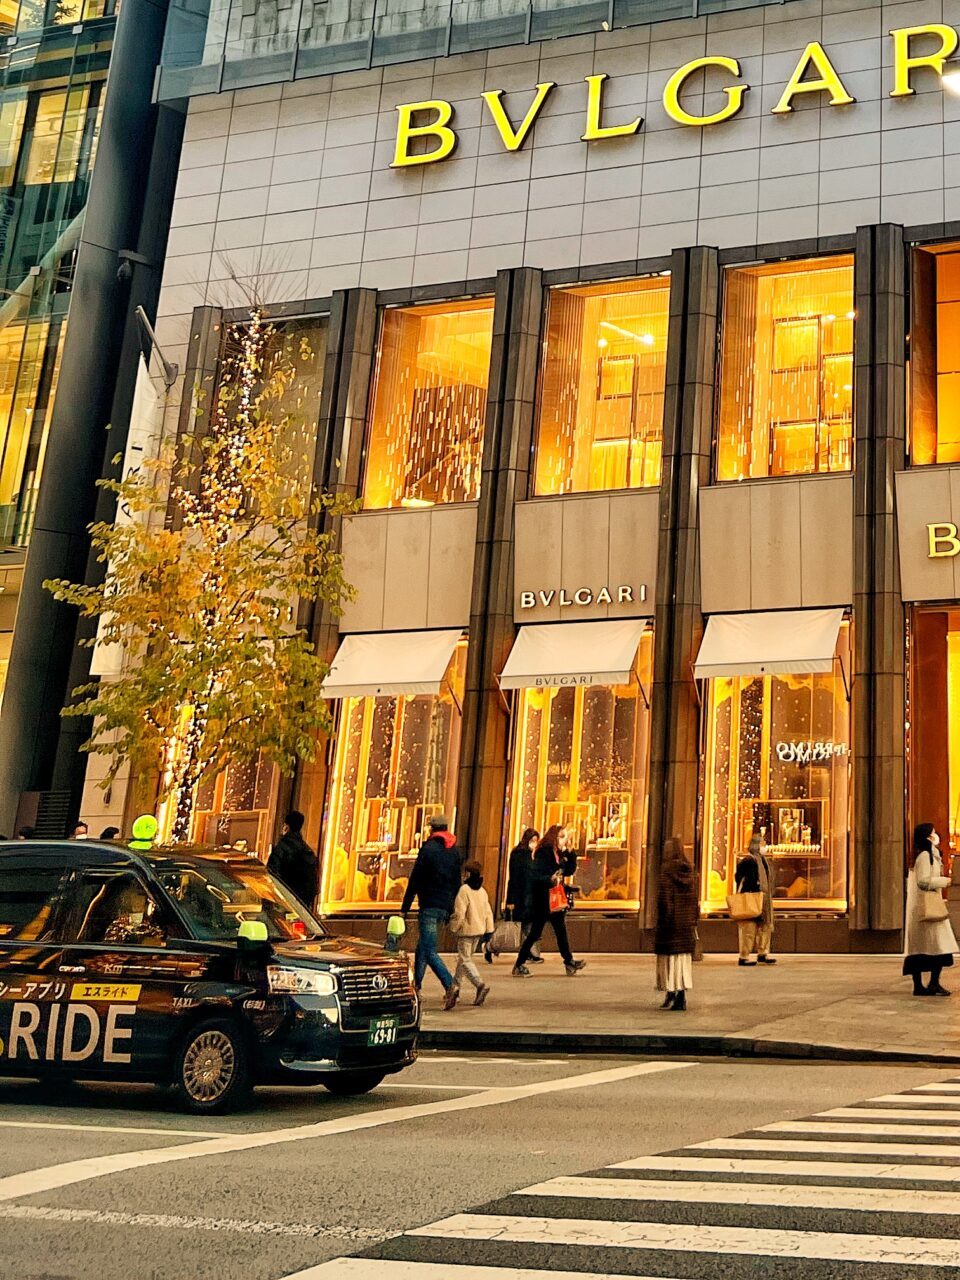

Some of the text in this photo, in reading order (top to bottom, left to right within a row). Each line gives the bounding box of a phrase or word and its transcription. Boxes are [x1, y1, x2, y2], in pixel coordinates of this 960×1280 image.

[520, 584, 647, 609] BVLGARI
[535, 675, 593, 686] BVLGARI
[82, 985, 129, 998] エスライド
[172, 997, 194, 1007] TAXI
